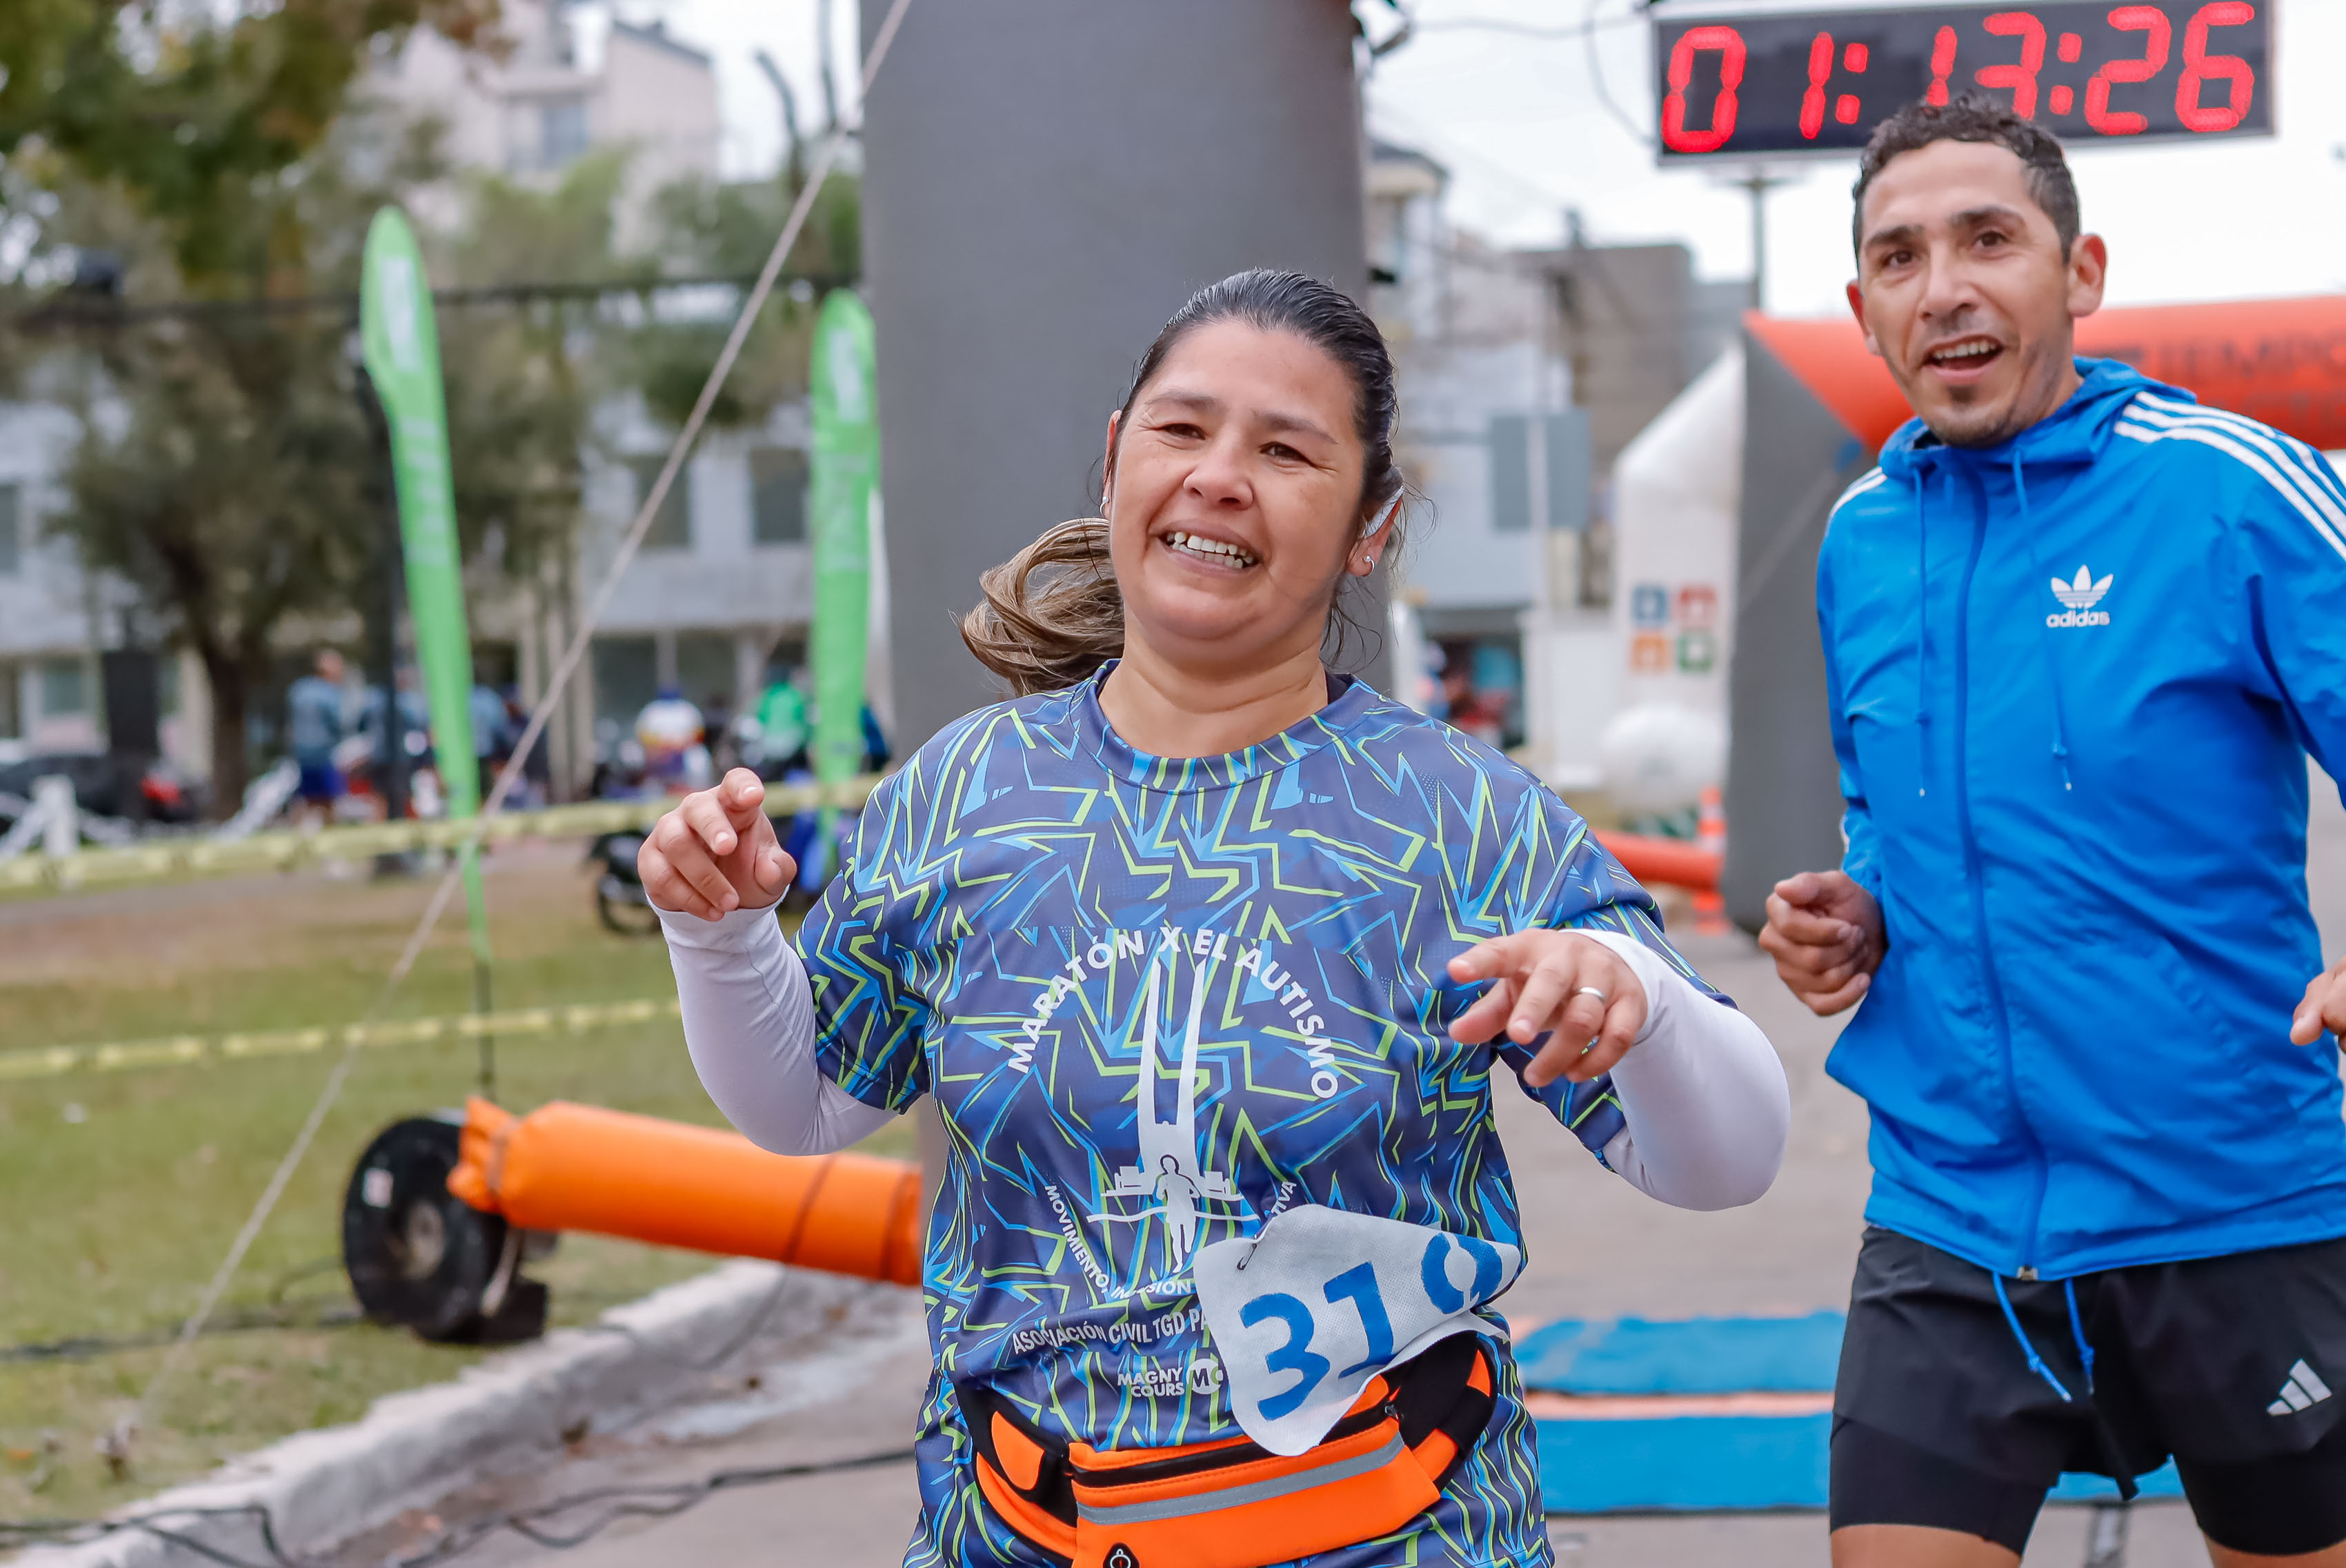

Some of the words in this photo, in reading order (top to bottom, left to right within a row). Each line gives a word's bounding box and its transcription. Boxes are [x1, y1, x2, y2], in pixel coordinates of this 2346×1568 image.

[2046, 609, 2111, 628] adidas
[1008, 928, 1145, 1074] MARATÓN
[1159, 926, 1182, 953] X
[1193, 928, 1229, 961] EL
[1234, 947, 1339, 1098] AUTISMO
[1012, 1320, 1107, 1355] ASOCIACIÓN
[1108, 1322, 1153, 1344] CIVIL
[1153, 1311, 1186, 1340] TGD
[1117, 1367, 1184, 1387] MAGNY
[1130, 1382, 1185, 1398] COURS
